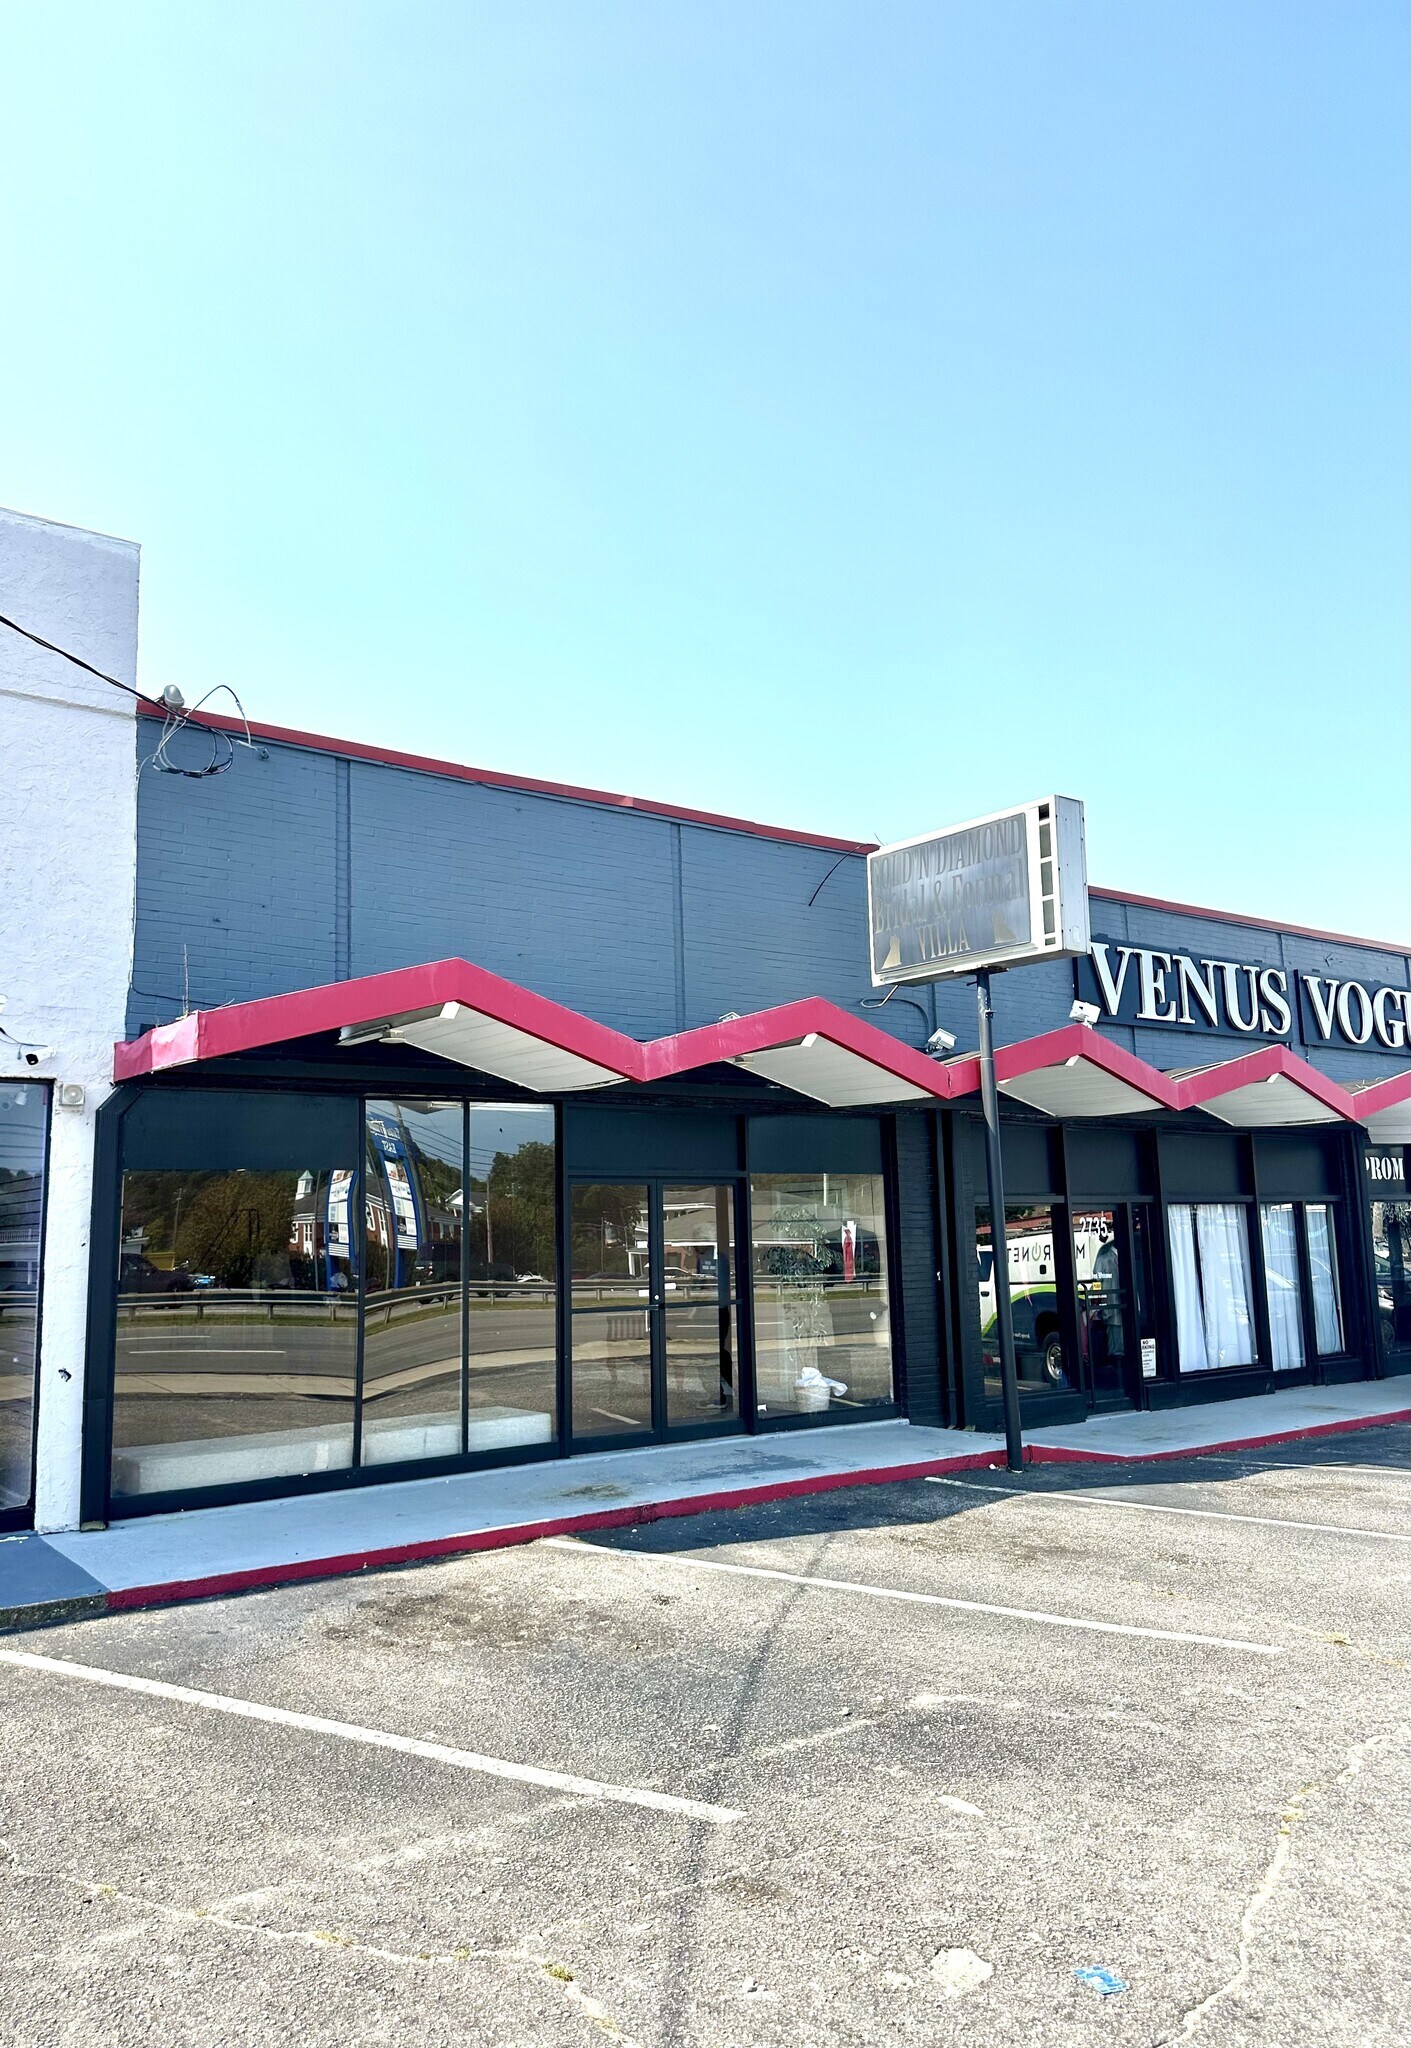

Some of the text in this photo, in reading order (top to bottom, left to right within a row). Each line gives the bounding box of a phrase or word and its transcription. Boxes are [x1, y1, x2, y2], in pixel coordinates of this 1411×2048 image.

[952, 858, 1025, 912] Formal
[915, 916, 971, 960] VILLA
[1090, 941, 1292, 1035] VENUS
[1079, 1216, 1108, 1237] 2735
